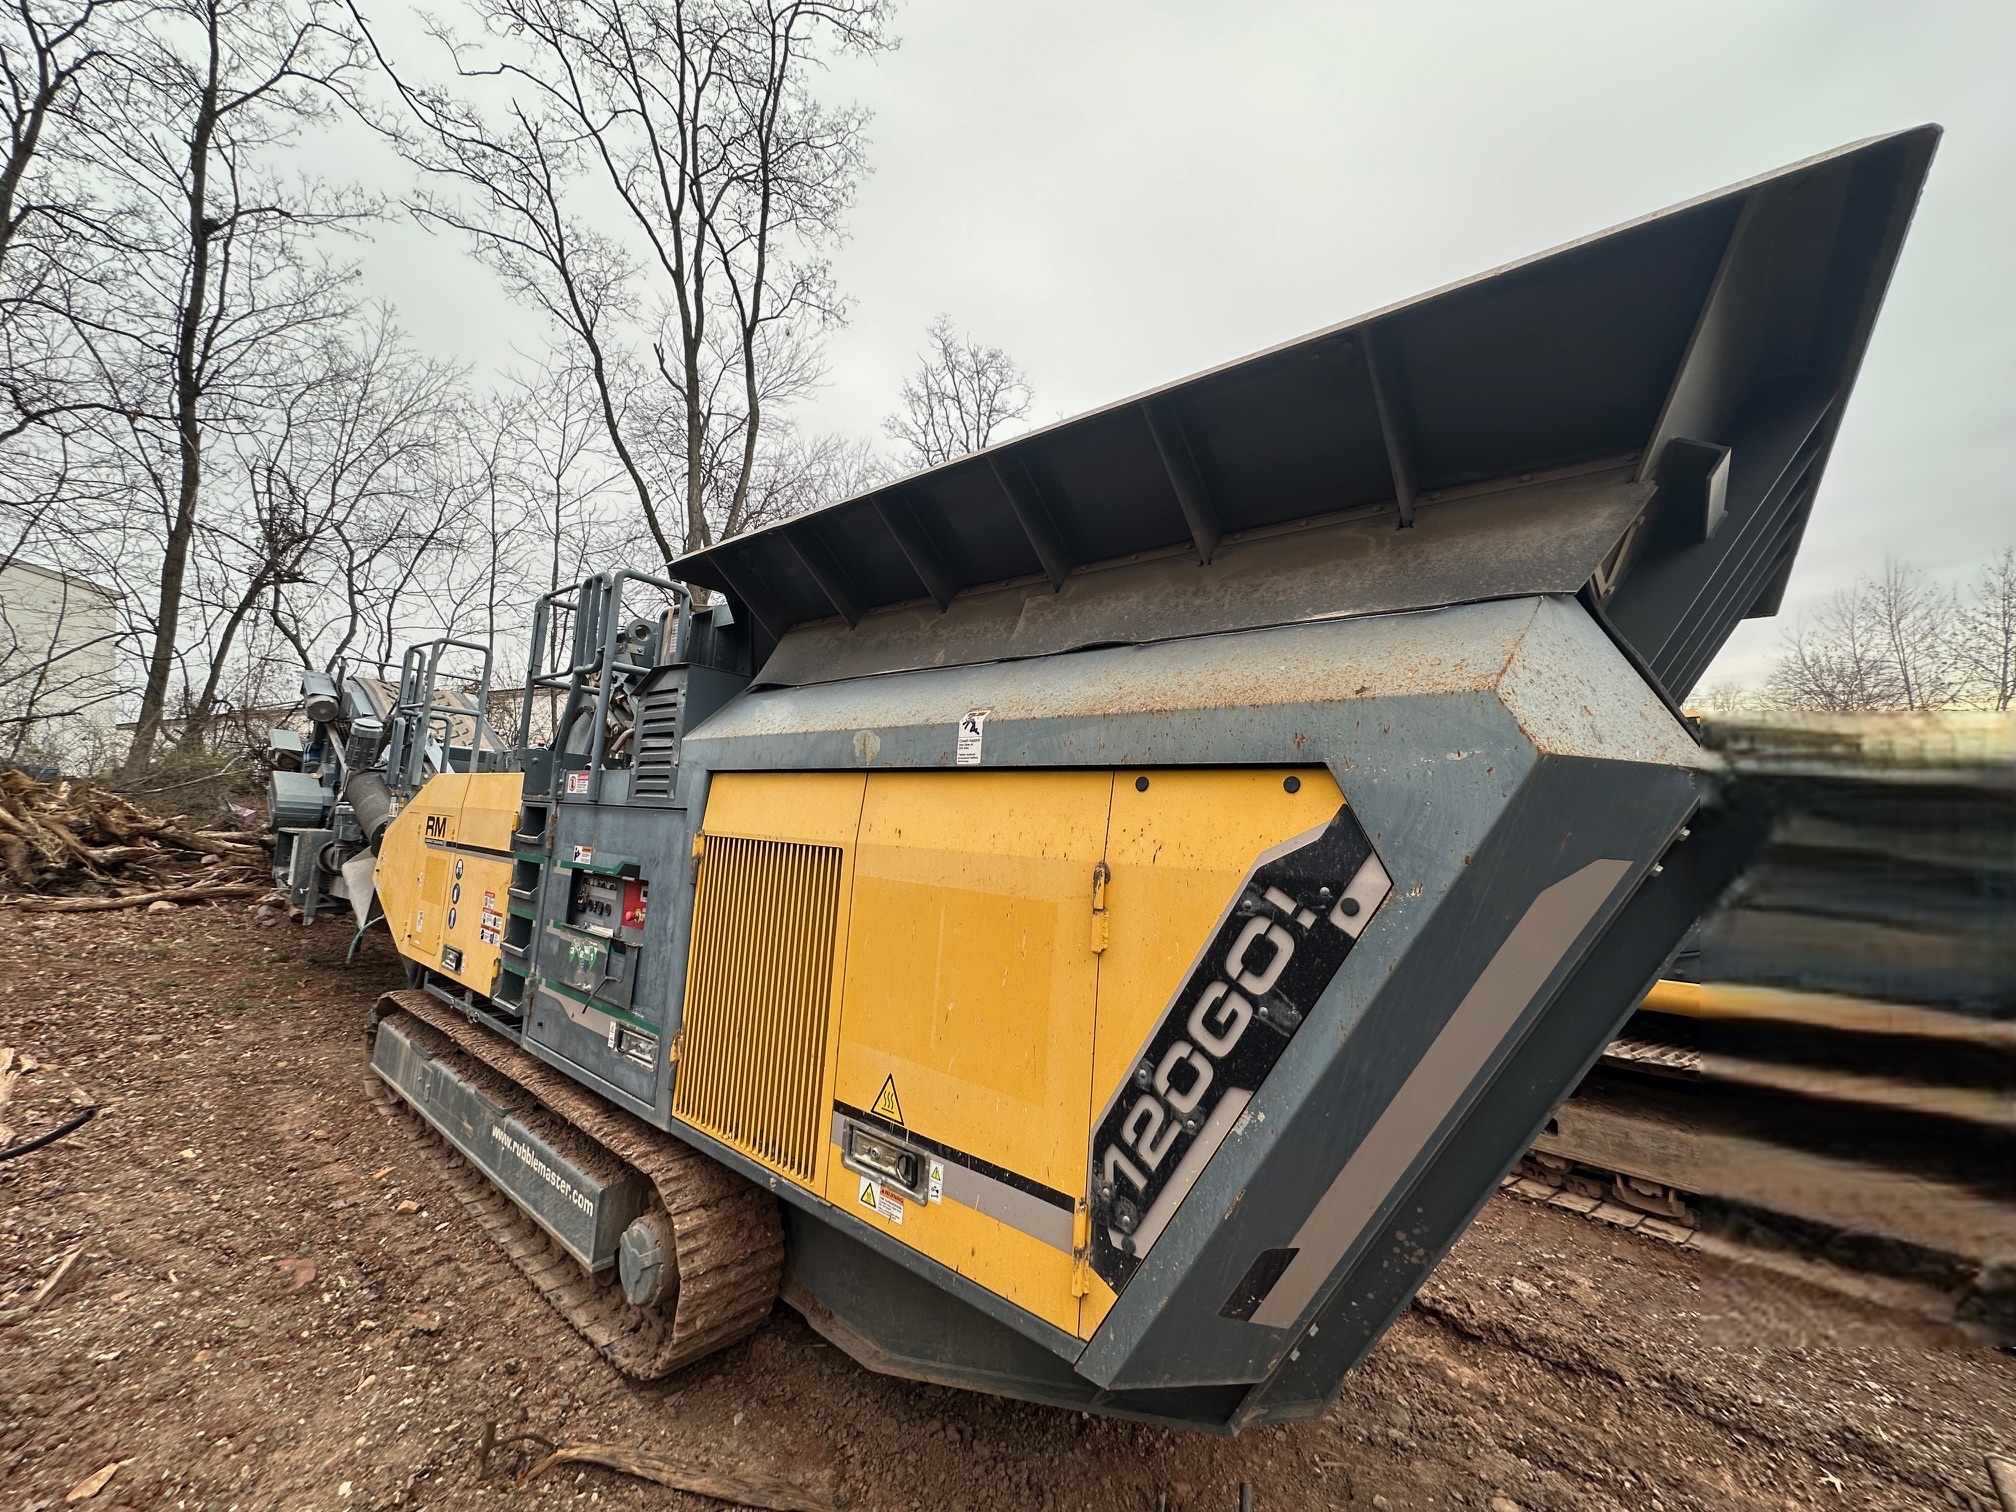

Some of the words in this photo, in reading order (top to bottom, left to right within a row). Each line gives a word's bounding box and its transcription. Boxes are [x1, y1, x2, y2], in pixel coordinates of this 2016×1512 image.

[425, 815, 447, 838] RM
[1103, 885, 1318, 1191] 120GO!
[492, 1124, 594, 1218] www.rubblemaster.com
